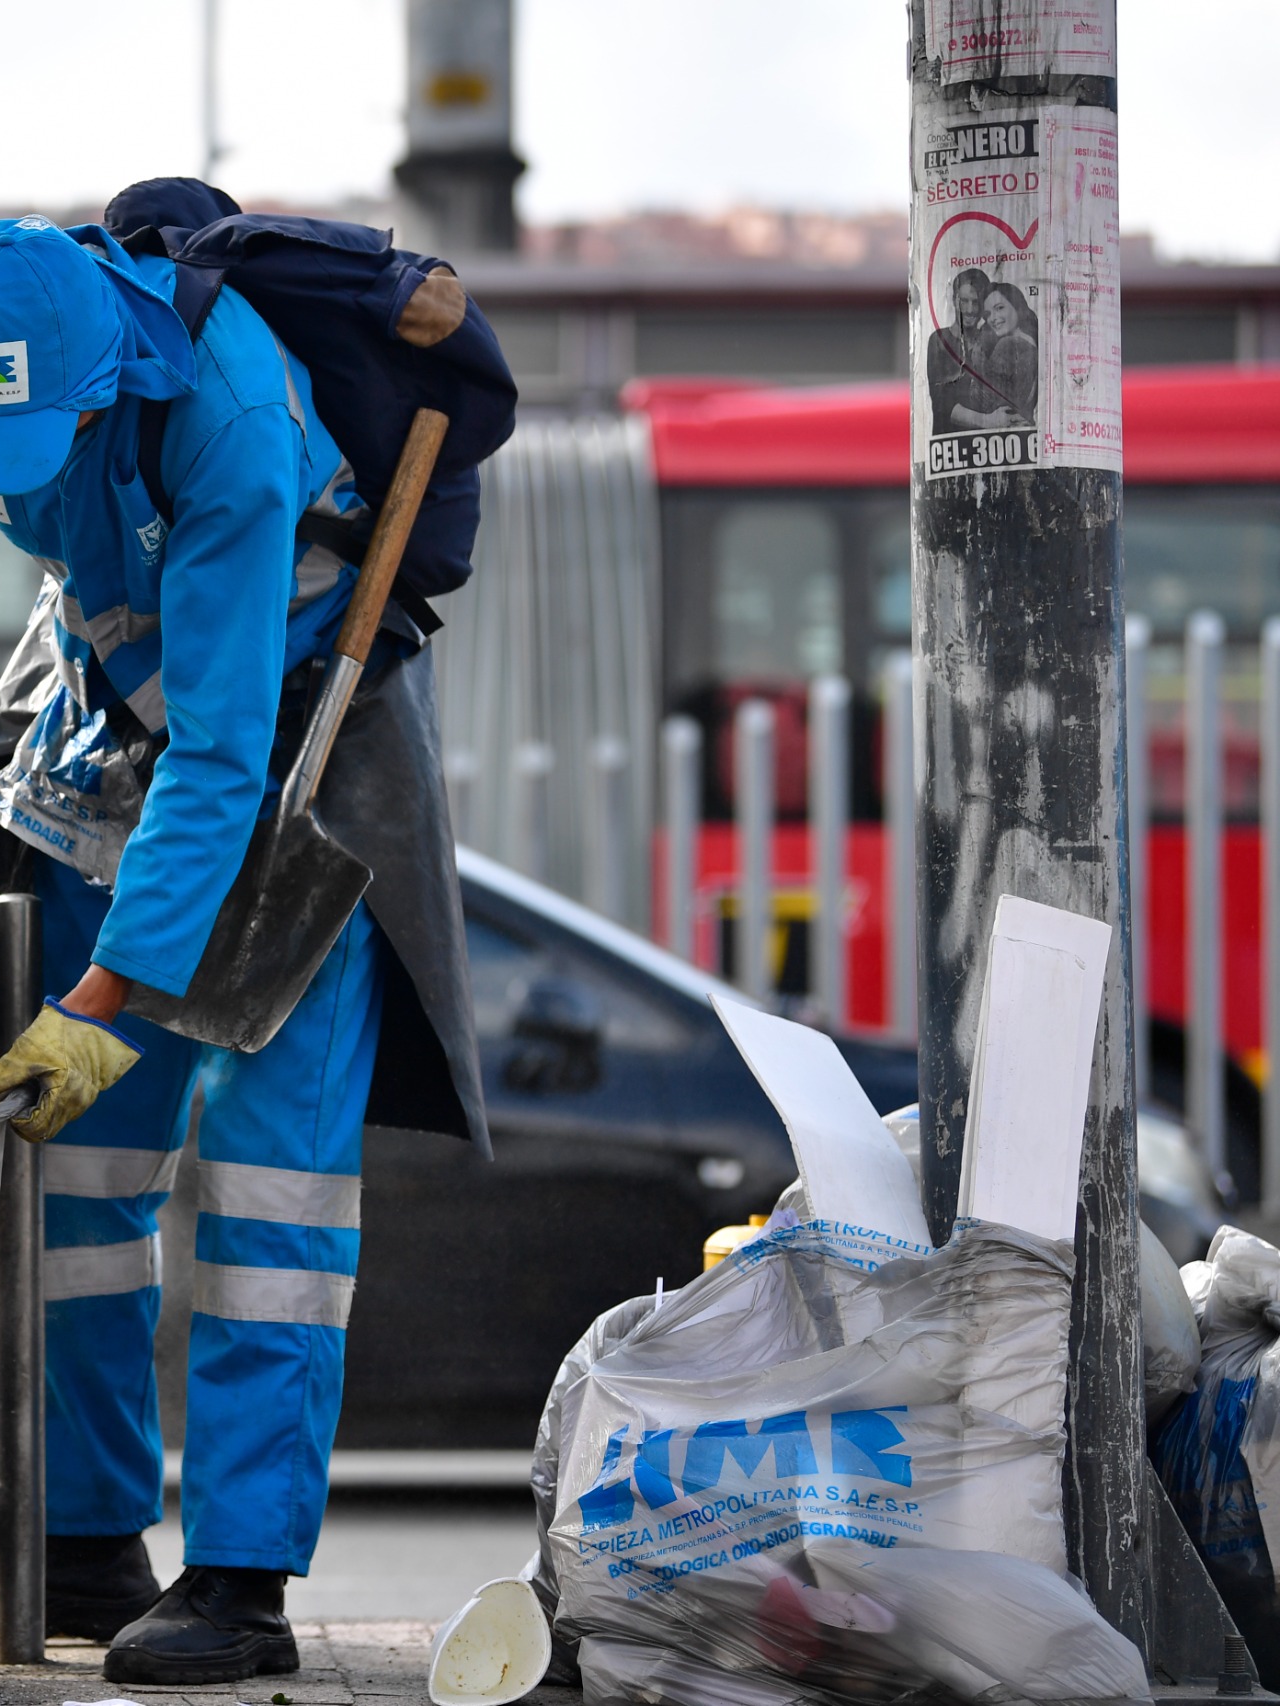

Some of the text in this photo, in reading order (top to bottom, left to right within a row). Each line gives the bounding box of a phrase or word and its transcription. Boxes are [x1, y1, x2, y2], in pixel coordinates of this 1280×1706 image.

[927, 173, 1018, 203] SECRETO
[950, 250, 1036, 267] Recuperación
[930, 439, 969, 472] CEL:
[972, 434, 1022, 467] 300
[578, 1484, 923, 1555] LPIEZA METROPOLITANA S.A.E.S.P.
[656, 1532, 717, 1557] METROPOLITANA
[834, 1509, 885, 1523] SANCIONES
[886, 1516, 924, 1533] PENALES
